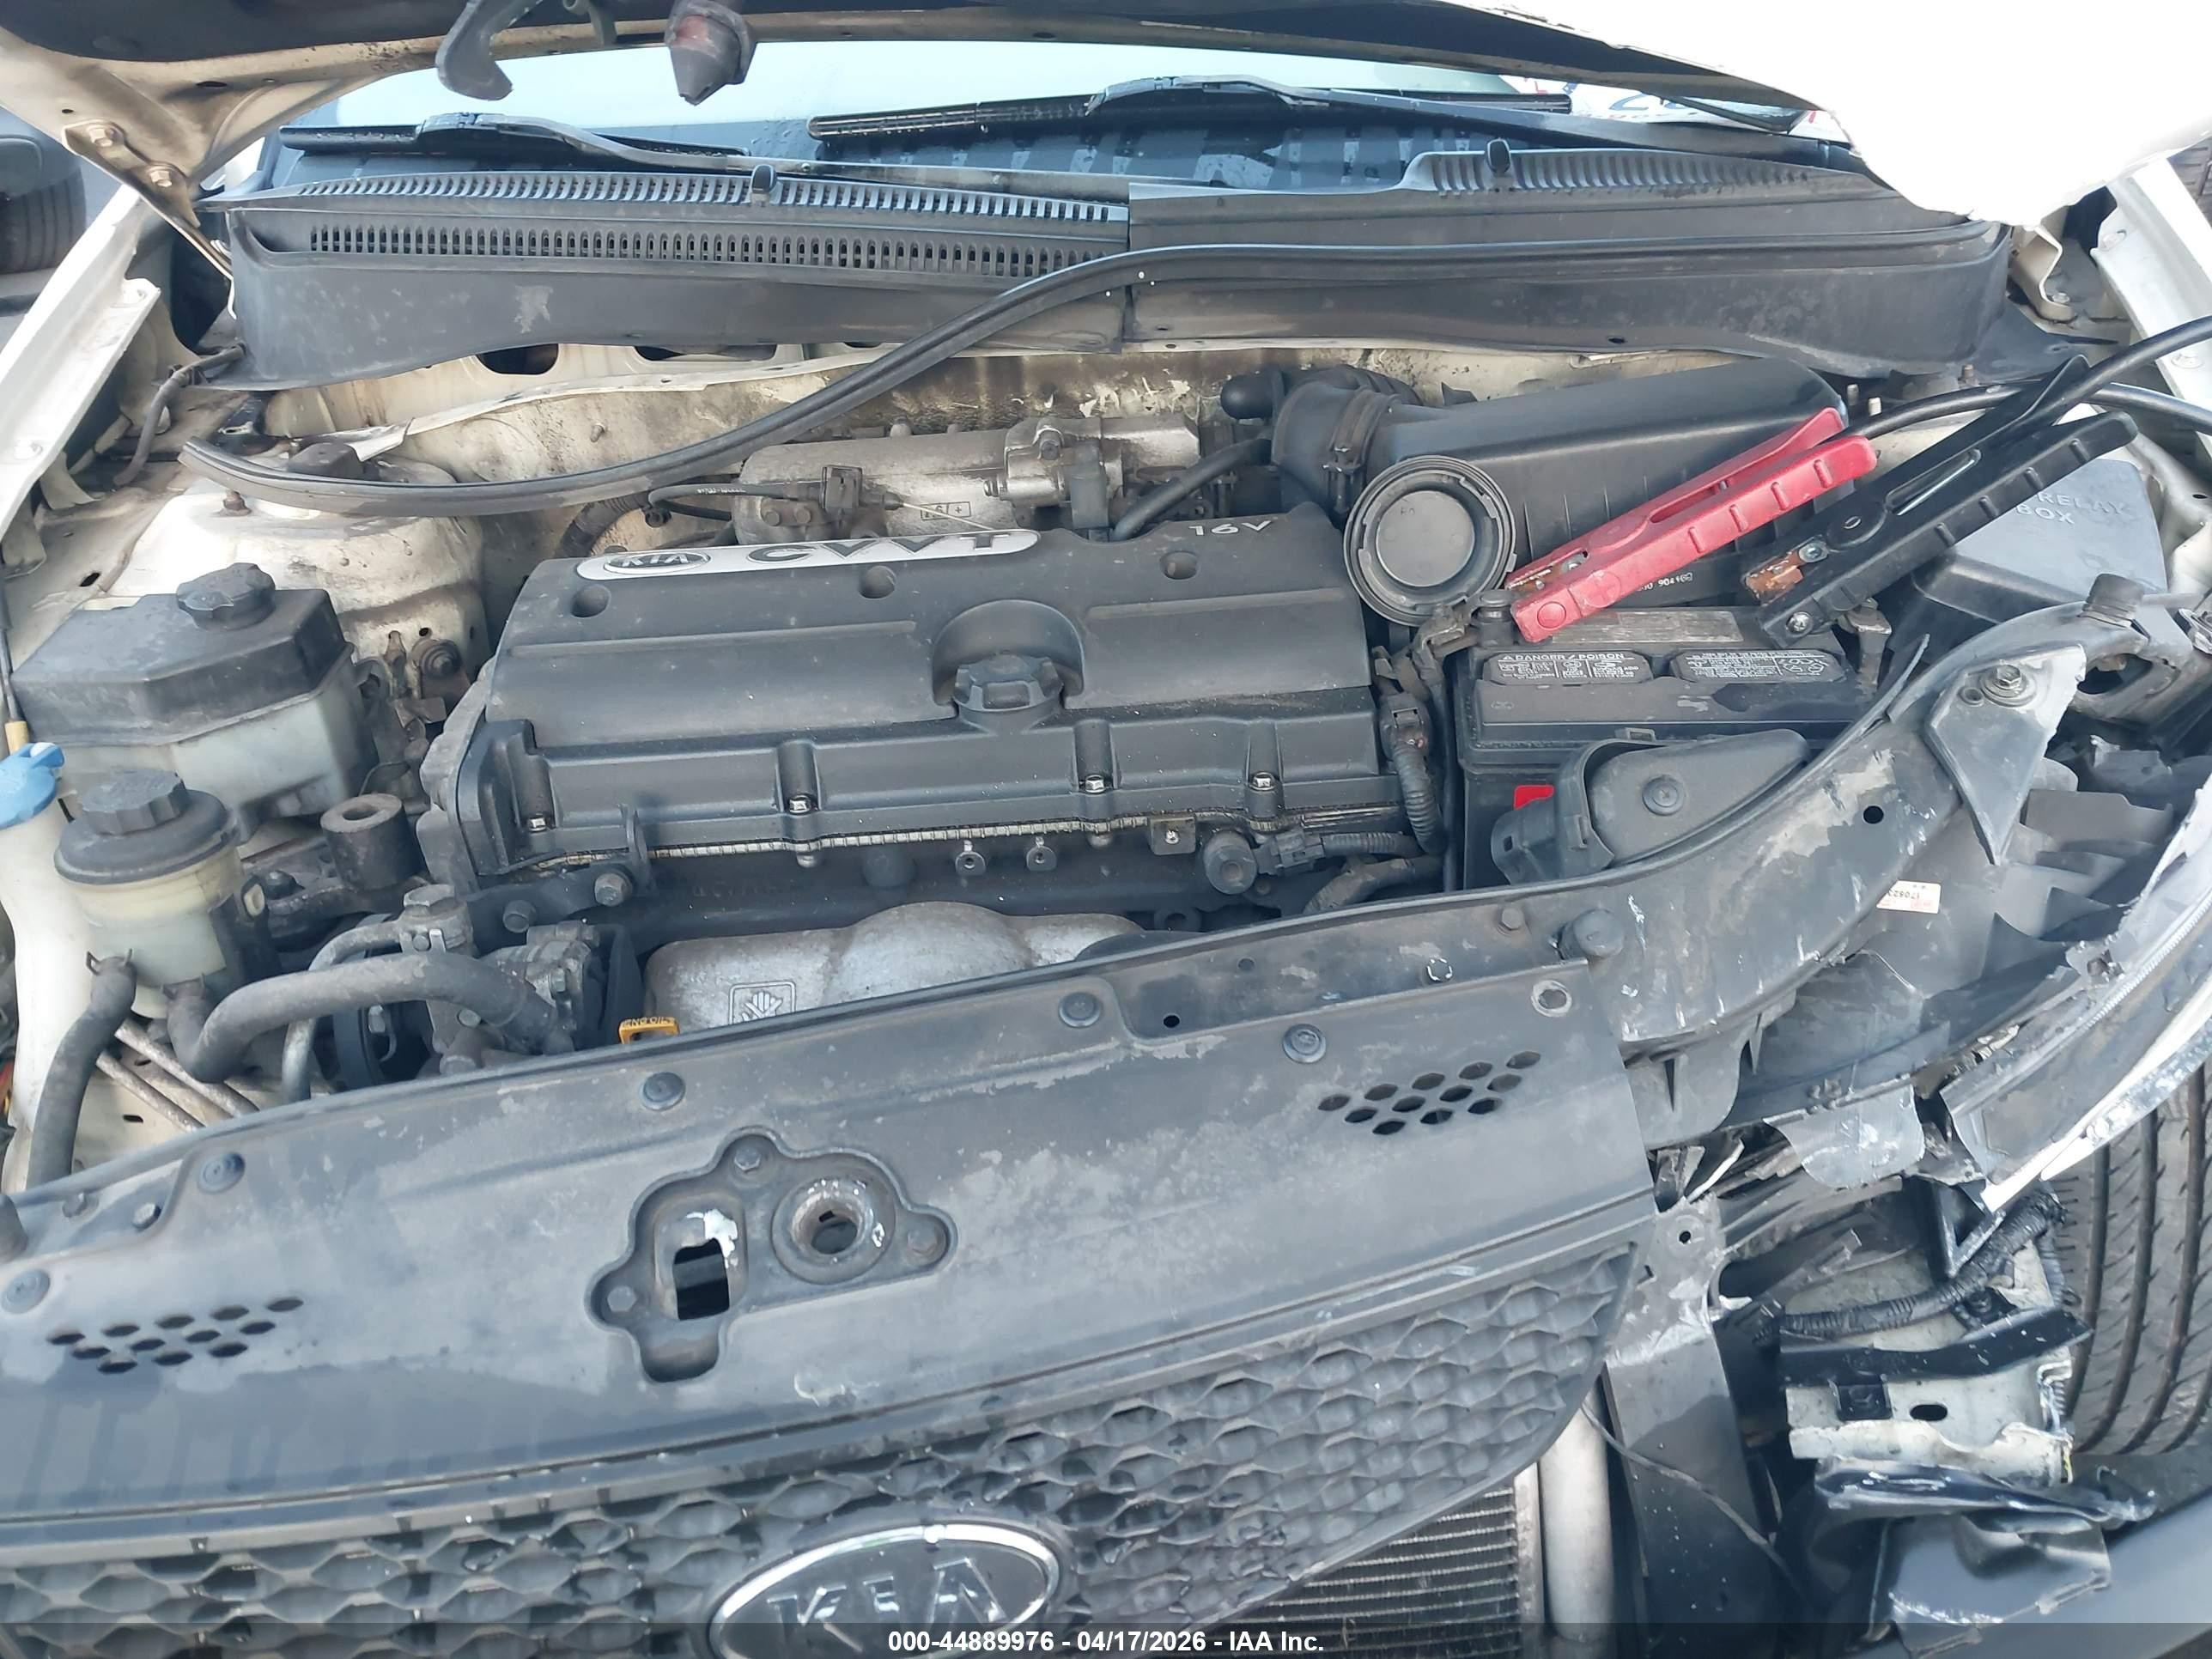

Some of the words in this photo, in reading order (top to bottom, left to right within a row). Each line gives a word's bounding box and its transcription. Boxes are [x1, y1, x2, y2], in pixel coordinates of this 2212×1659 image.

[2015, 503, 2075, 525] BOX
[2036, 491, 2123, 515] RELAY
[1188, 520, 1272, 536] 16V
[618, 552, 689, 567] KIA
[747, 533, 1009, 563] CVVT
[767, 1557, 1008, 1653] KIA
